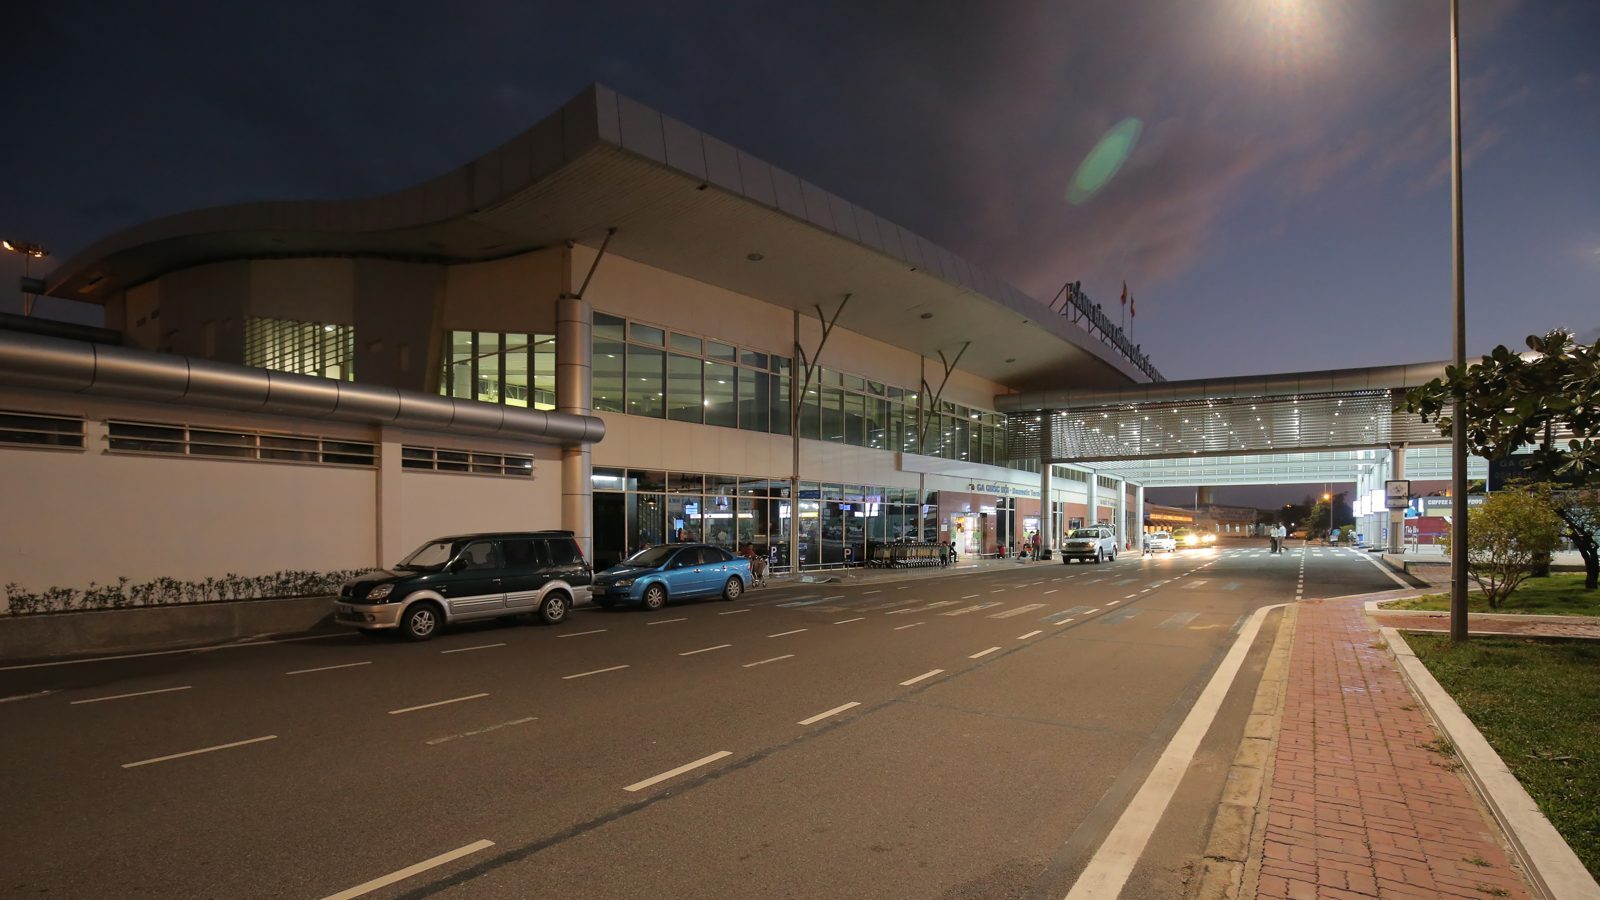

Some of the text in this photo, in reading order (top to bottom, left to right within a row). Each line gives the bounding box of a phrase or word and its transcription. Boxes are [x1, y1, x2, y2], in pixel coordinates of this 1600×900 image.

[977, 483, 985, 491] GA
[770, 546, 778, 557] P
[844, 548, 852, 559] P
